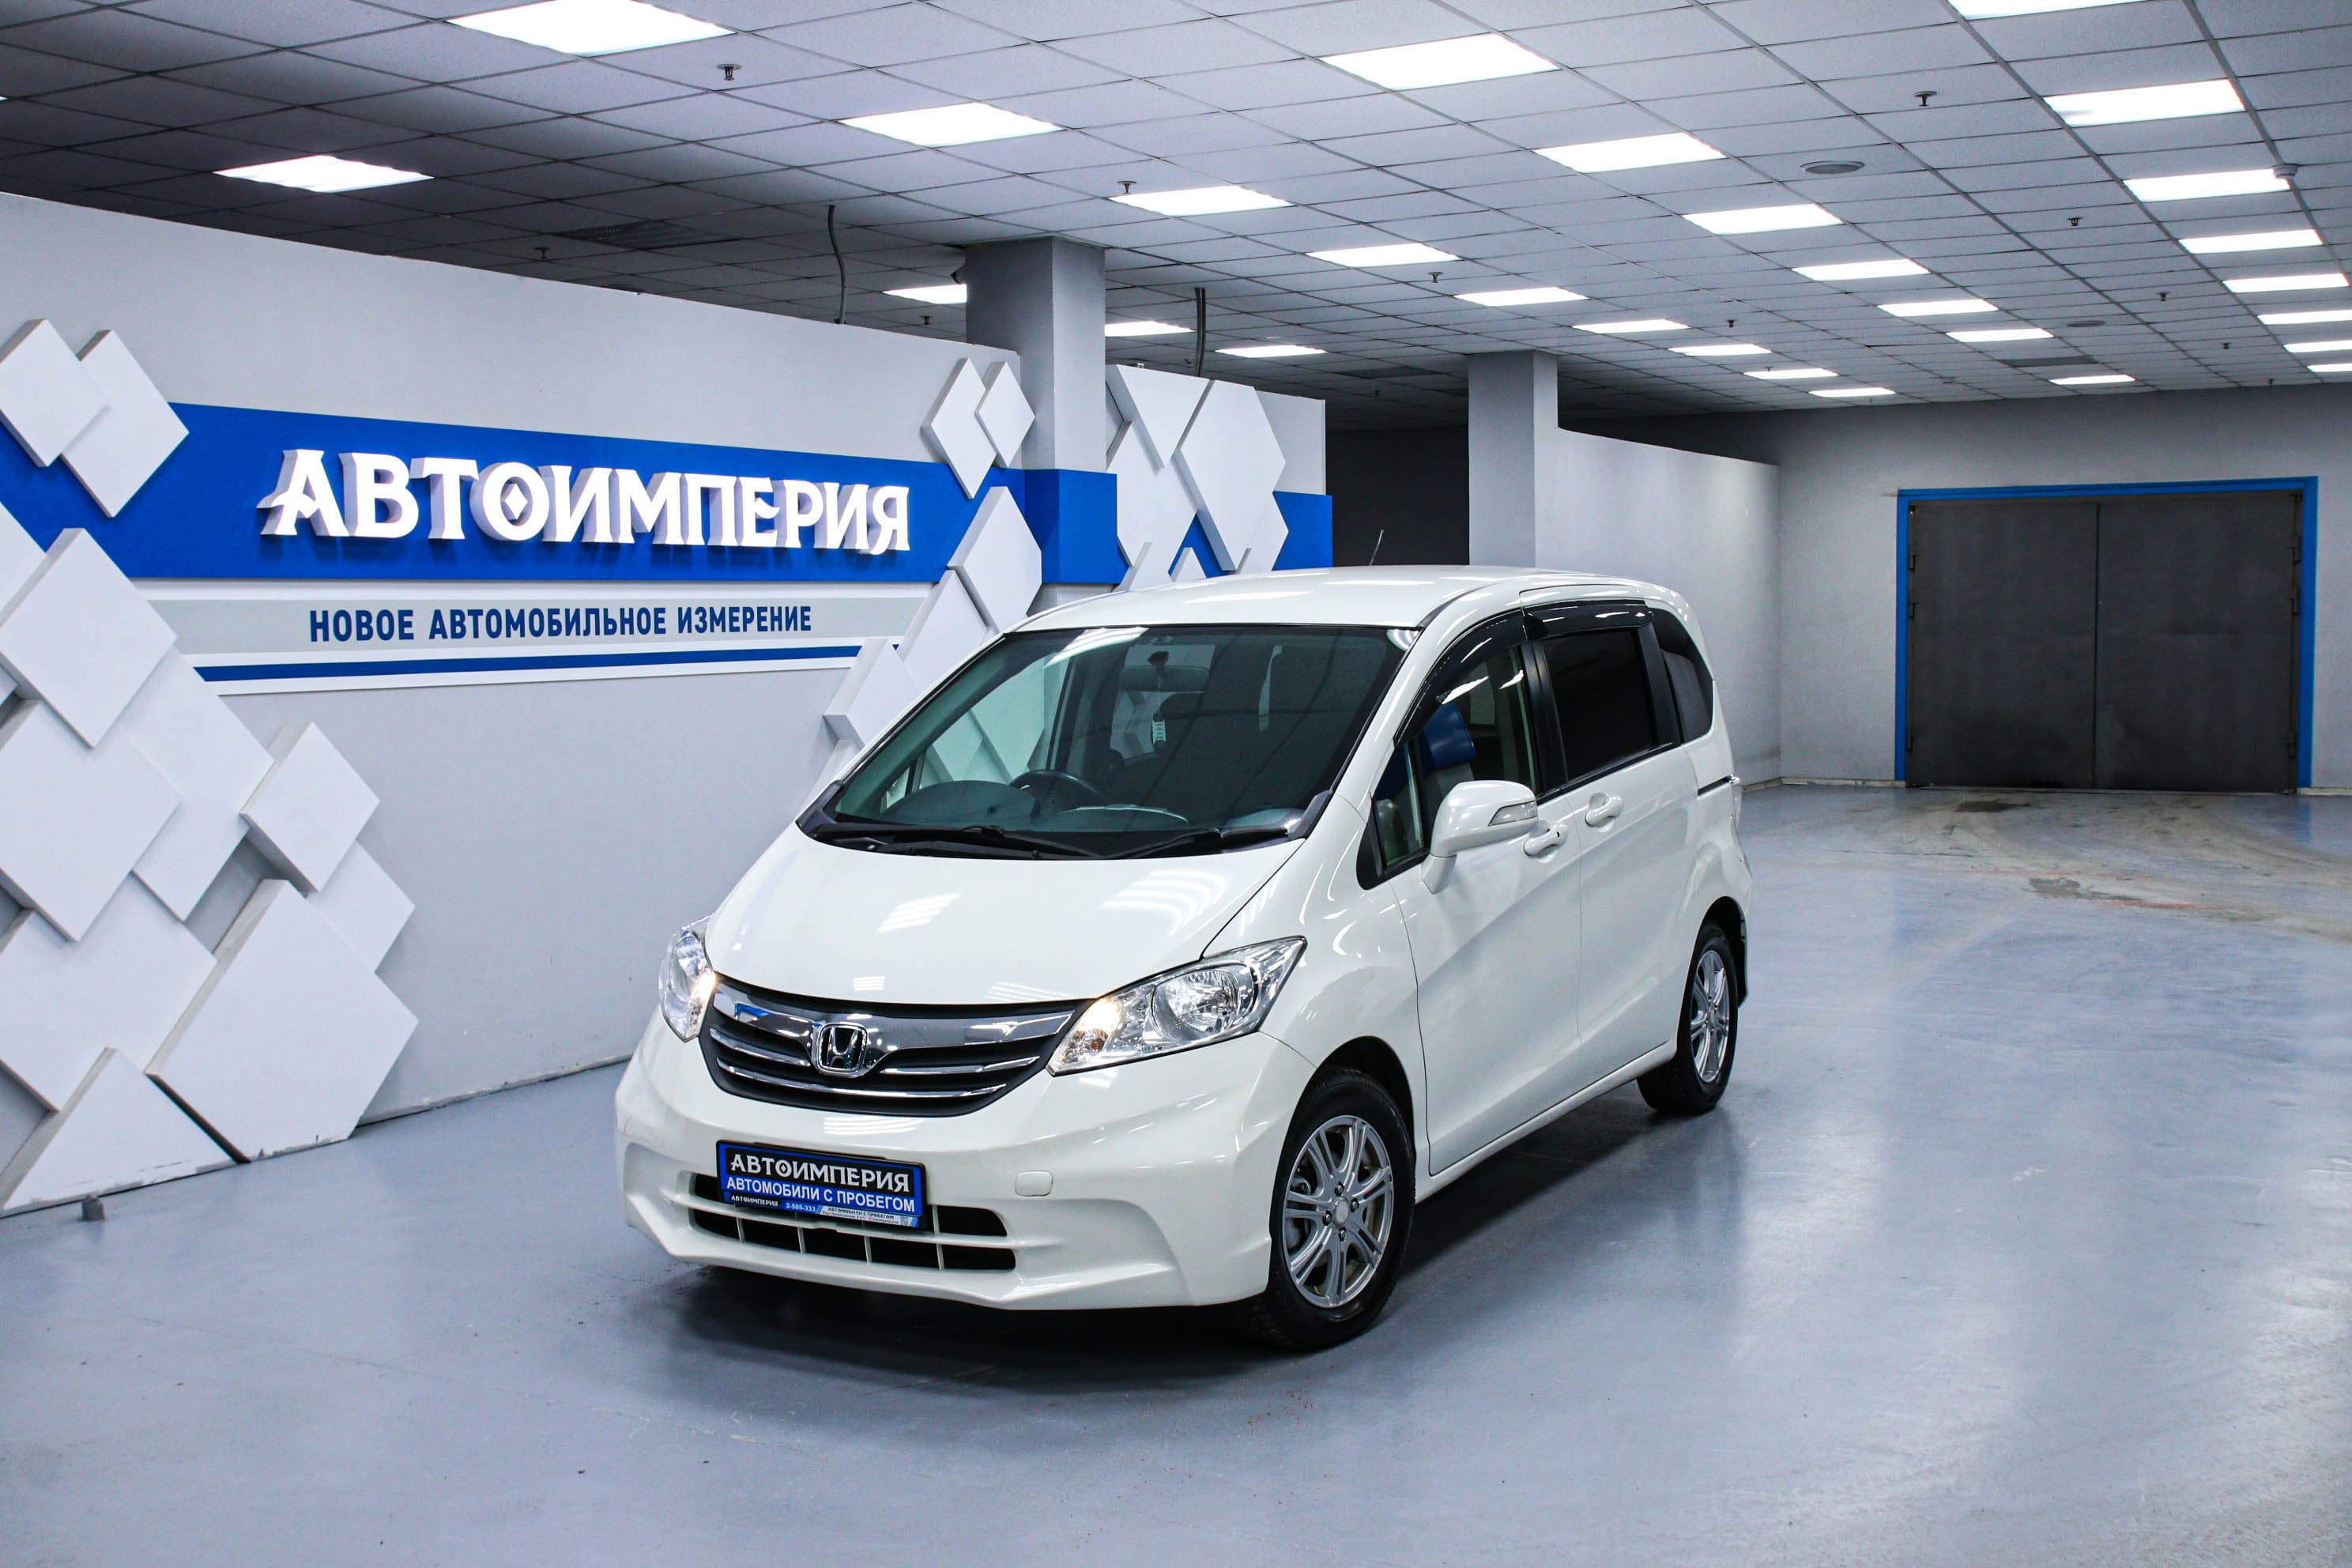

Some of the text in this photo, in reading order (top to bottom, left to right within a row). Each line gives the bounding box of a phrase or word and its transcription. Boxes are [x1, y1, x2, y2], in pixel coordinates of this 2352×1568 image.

[257, 448, 910, 556] АВТОИМПЕРИЯ
[309, 605, 812, 643] НОВОЕ АВТОМОБИЛЬНОЕ ИЗМЕРЕНИЕ
[730, 1153, 910, 1193] АВТОИМПЕРИЯ
[726, 1177, 915, 1212] АВТОМОБИЛИ С ПРОБЕГОМ
[731, 1195, 778, 1208] АВТОИМПЕРИЯ
